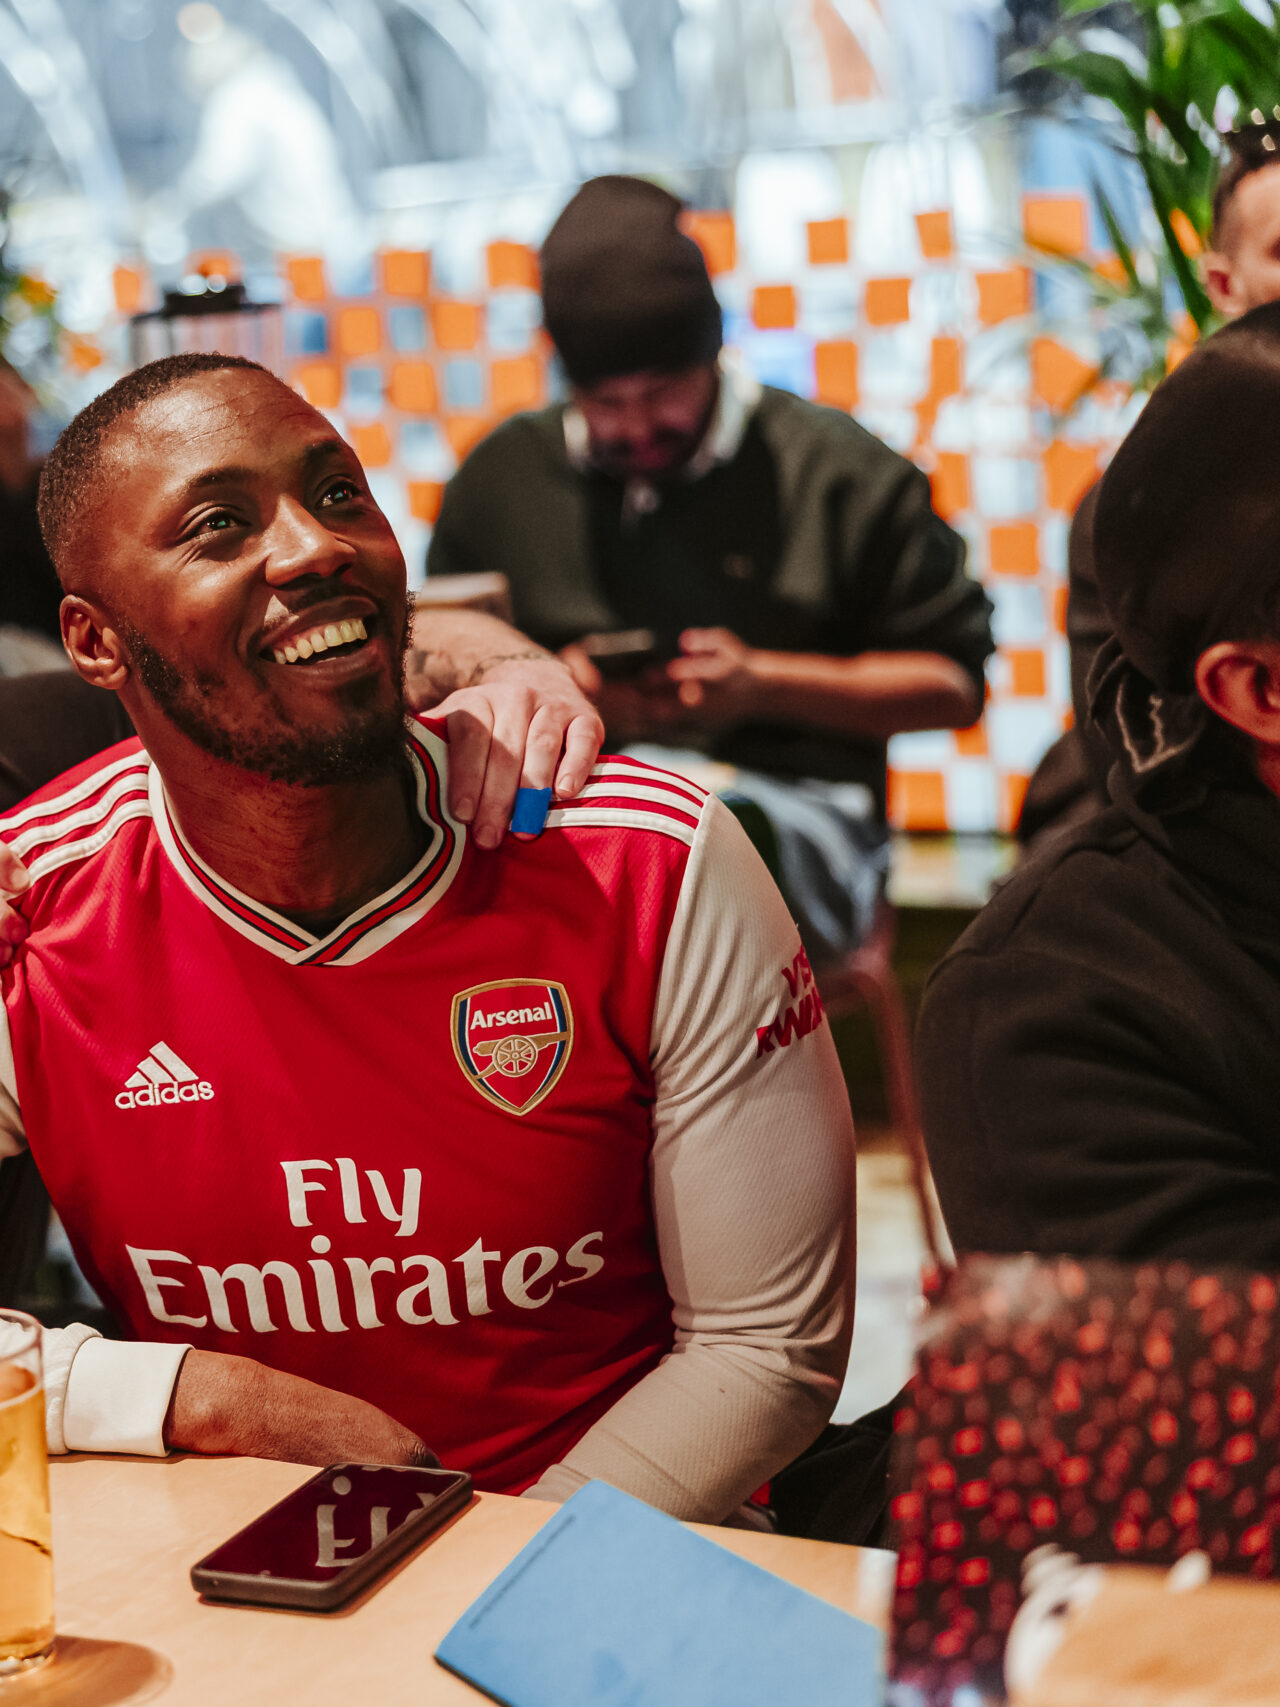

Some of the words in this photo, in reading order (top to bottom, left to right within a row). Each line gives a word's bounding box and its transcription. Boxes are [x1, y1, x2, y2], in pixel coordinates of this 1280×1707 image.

[470, 1001, 553, 1031] Arsenal
[114, 1081, 215, 1110] adidas
[279, 1157, 422, 1237] Fly
[124, 1230, 606, 1334] Emirates
